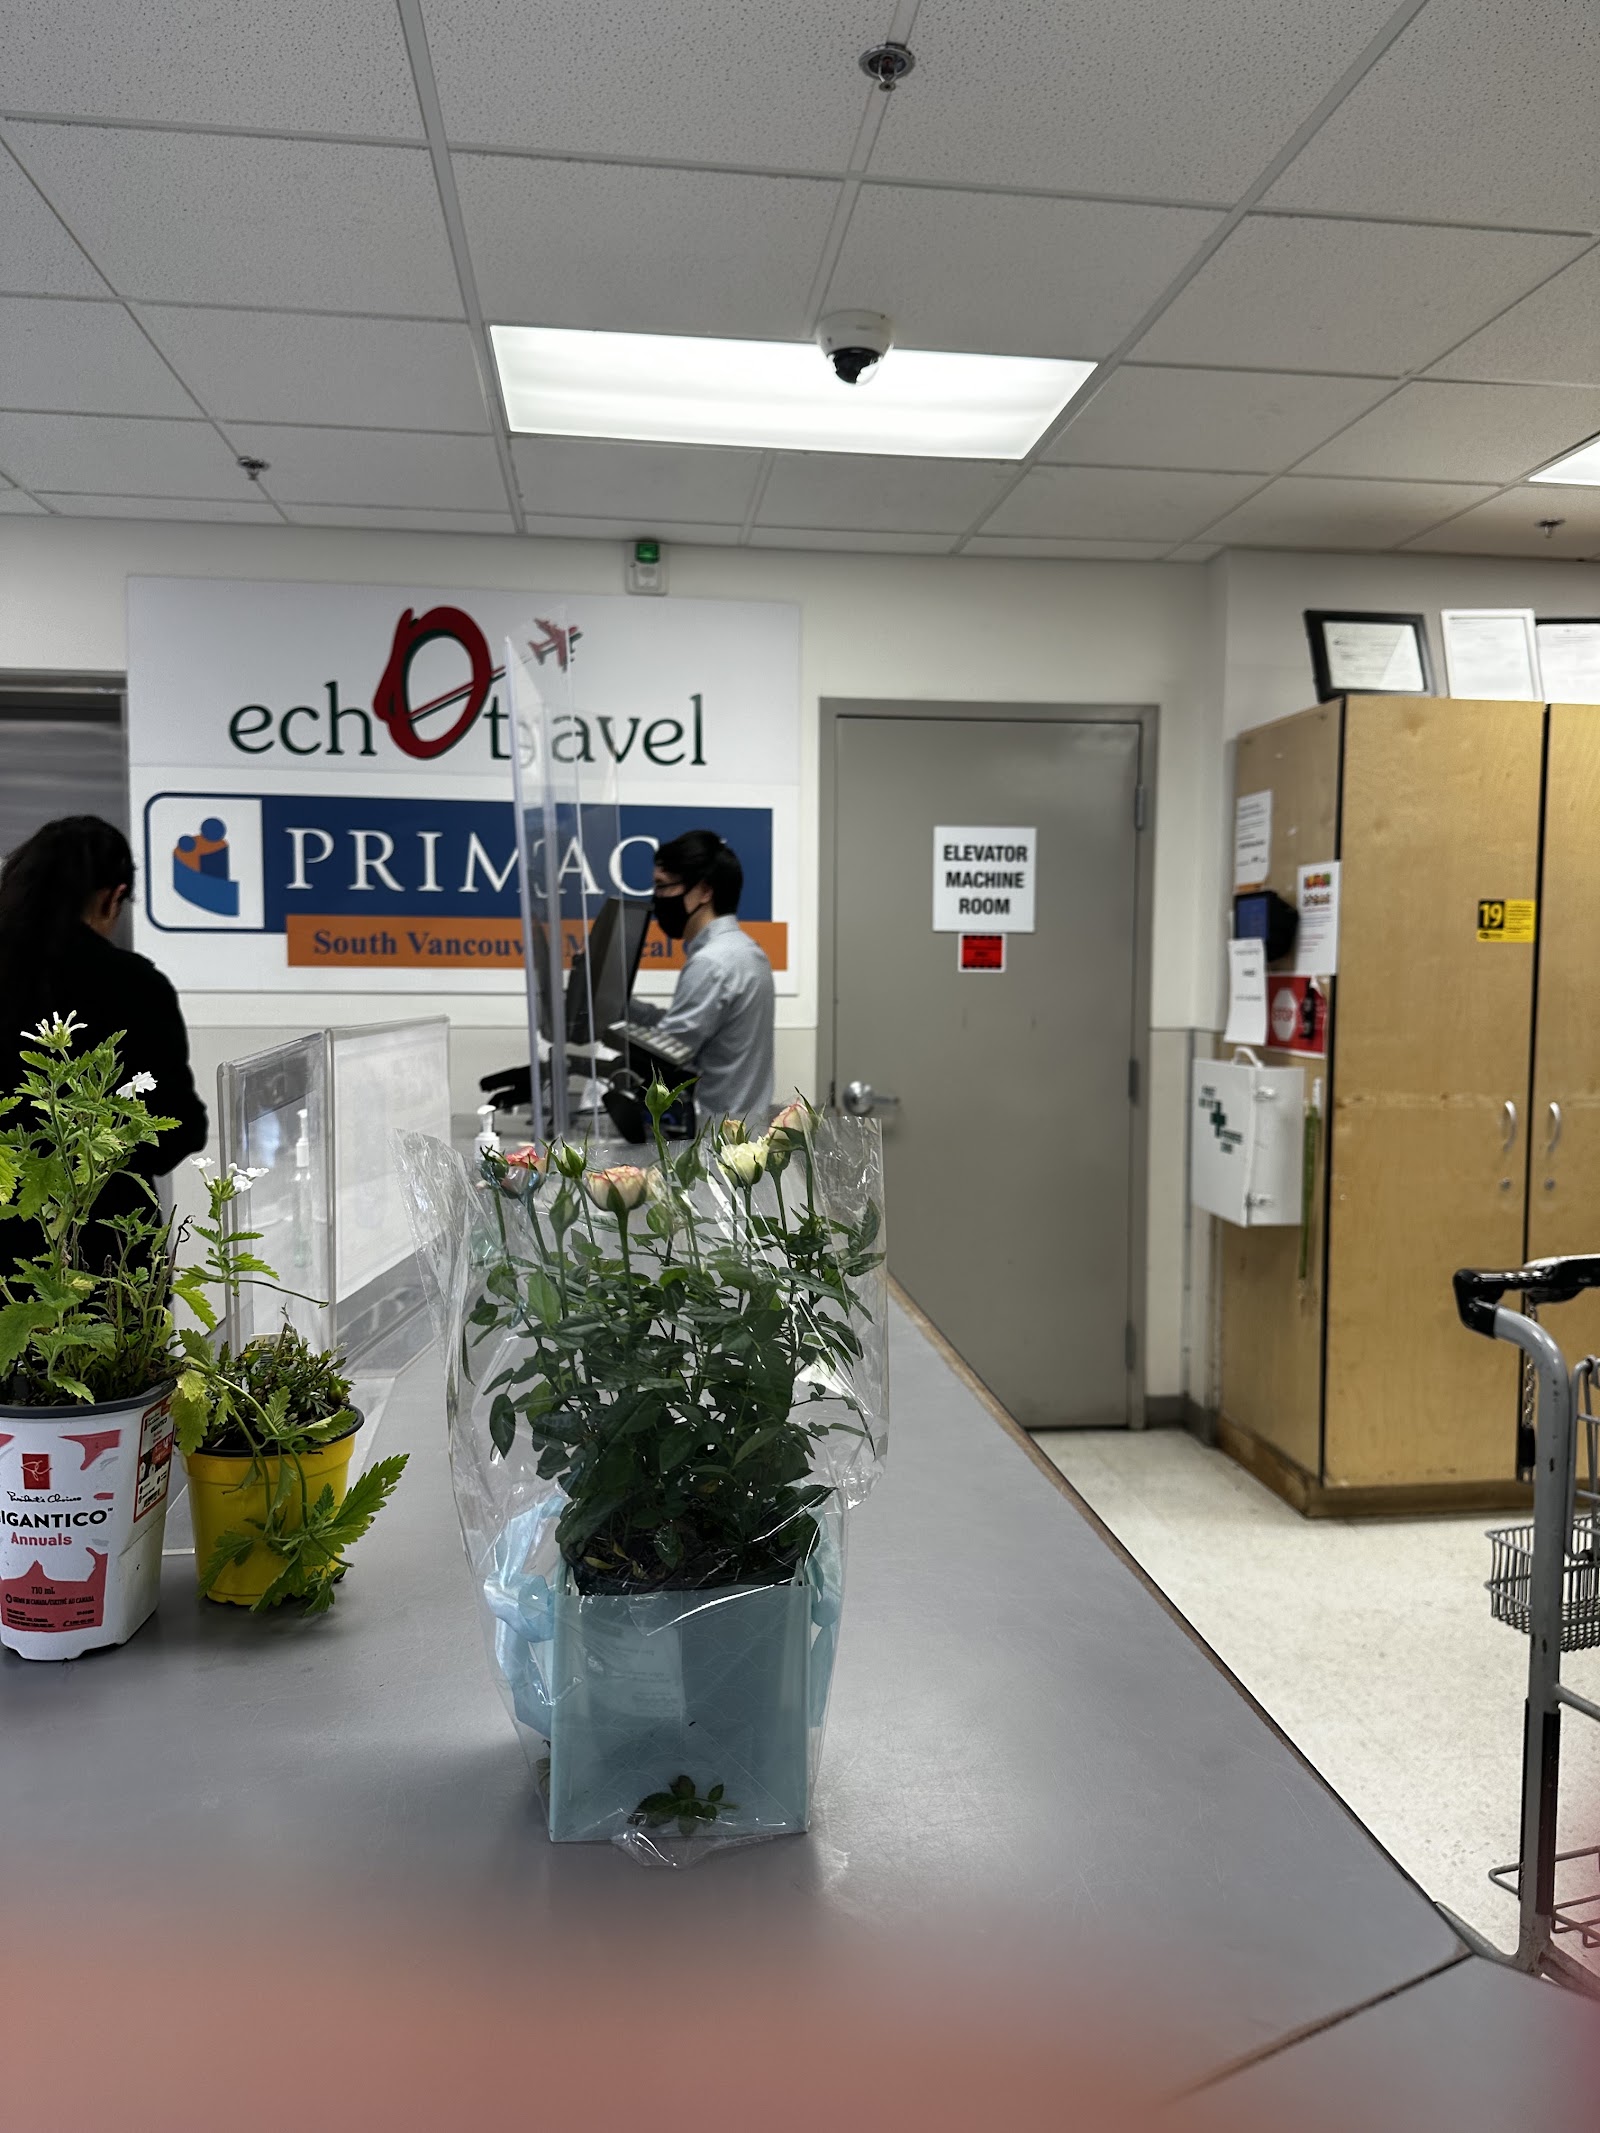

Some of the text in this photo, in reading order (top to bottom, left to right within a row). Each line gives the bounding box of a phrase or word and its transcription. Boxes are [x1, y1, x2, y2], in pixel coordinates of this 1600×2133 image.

[943, 845, 1028, 862] ELEVATOR
[945, 871, 1025, 889] MACHINE
[958, 898, 1010, 915] ROOM
[1479, 903, 1503, 928] 19
[313, 928, 526, 957] South Vancouv
[11, 1531, 73, 1546] Annuals
